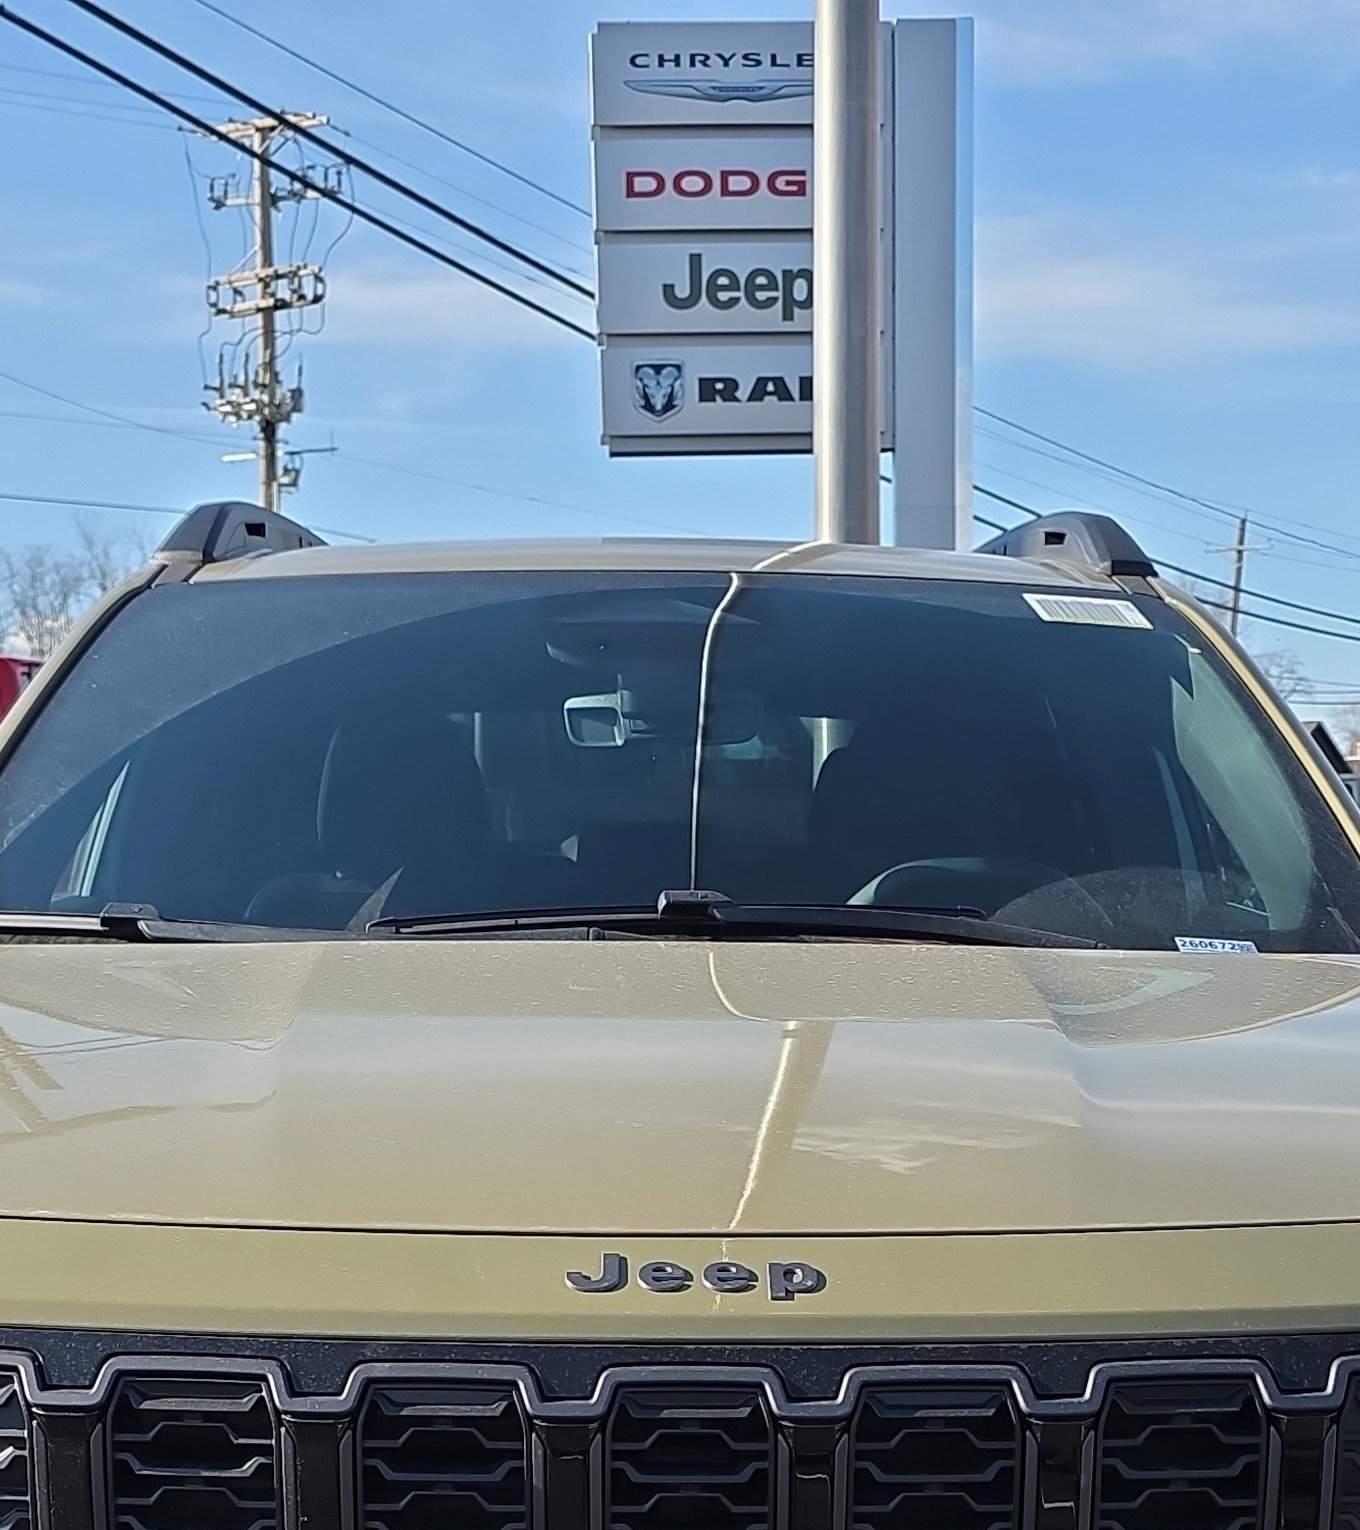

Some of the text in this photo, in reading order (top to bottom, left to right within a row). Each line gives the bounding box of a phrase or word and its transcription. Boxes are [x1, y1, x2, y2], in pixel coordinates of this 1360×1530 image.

[629, 52, 814, 69] CHRYSLE
[625, 170, 808, 198] DODG
[662, 253, 814, 322] Jeep
[698, 376, 814, 403] RA
[1179, 939, 1239, 951] 260672
[565, 1253, 828, 1301] Jeep
